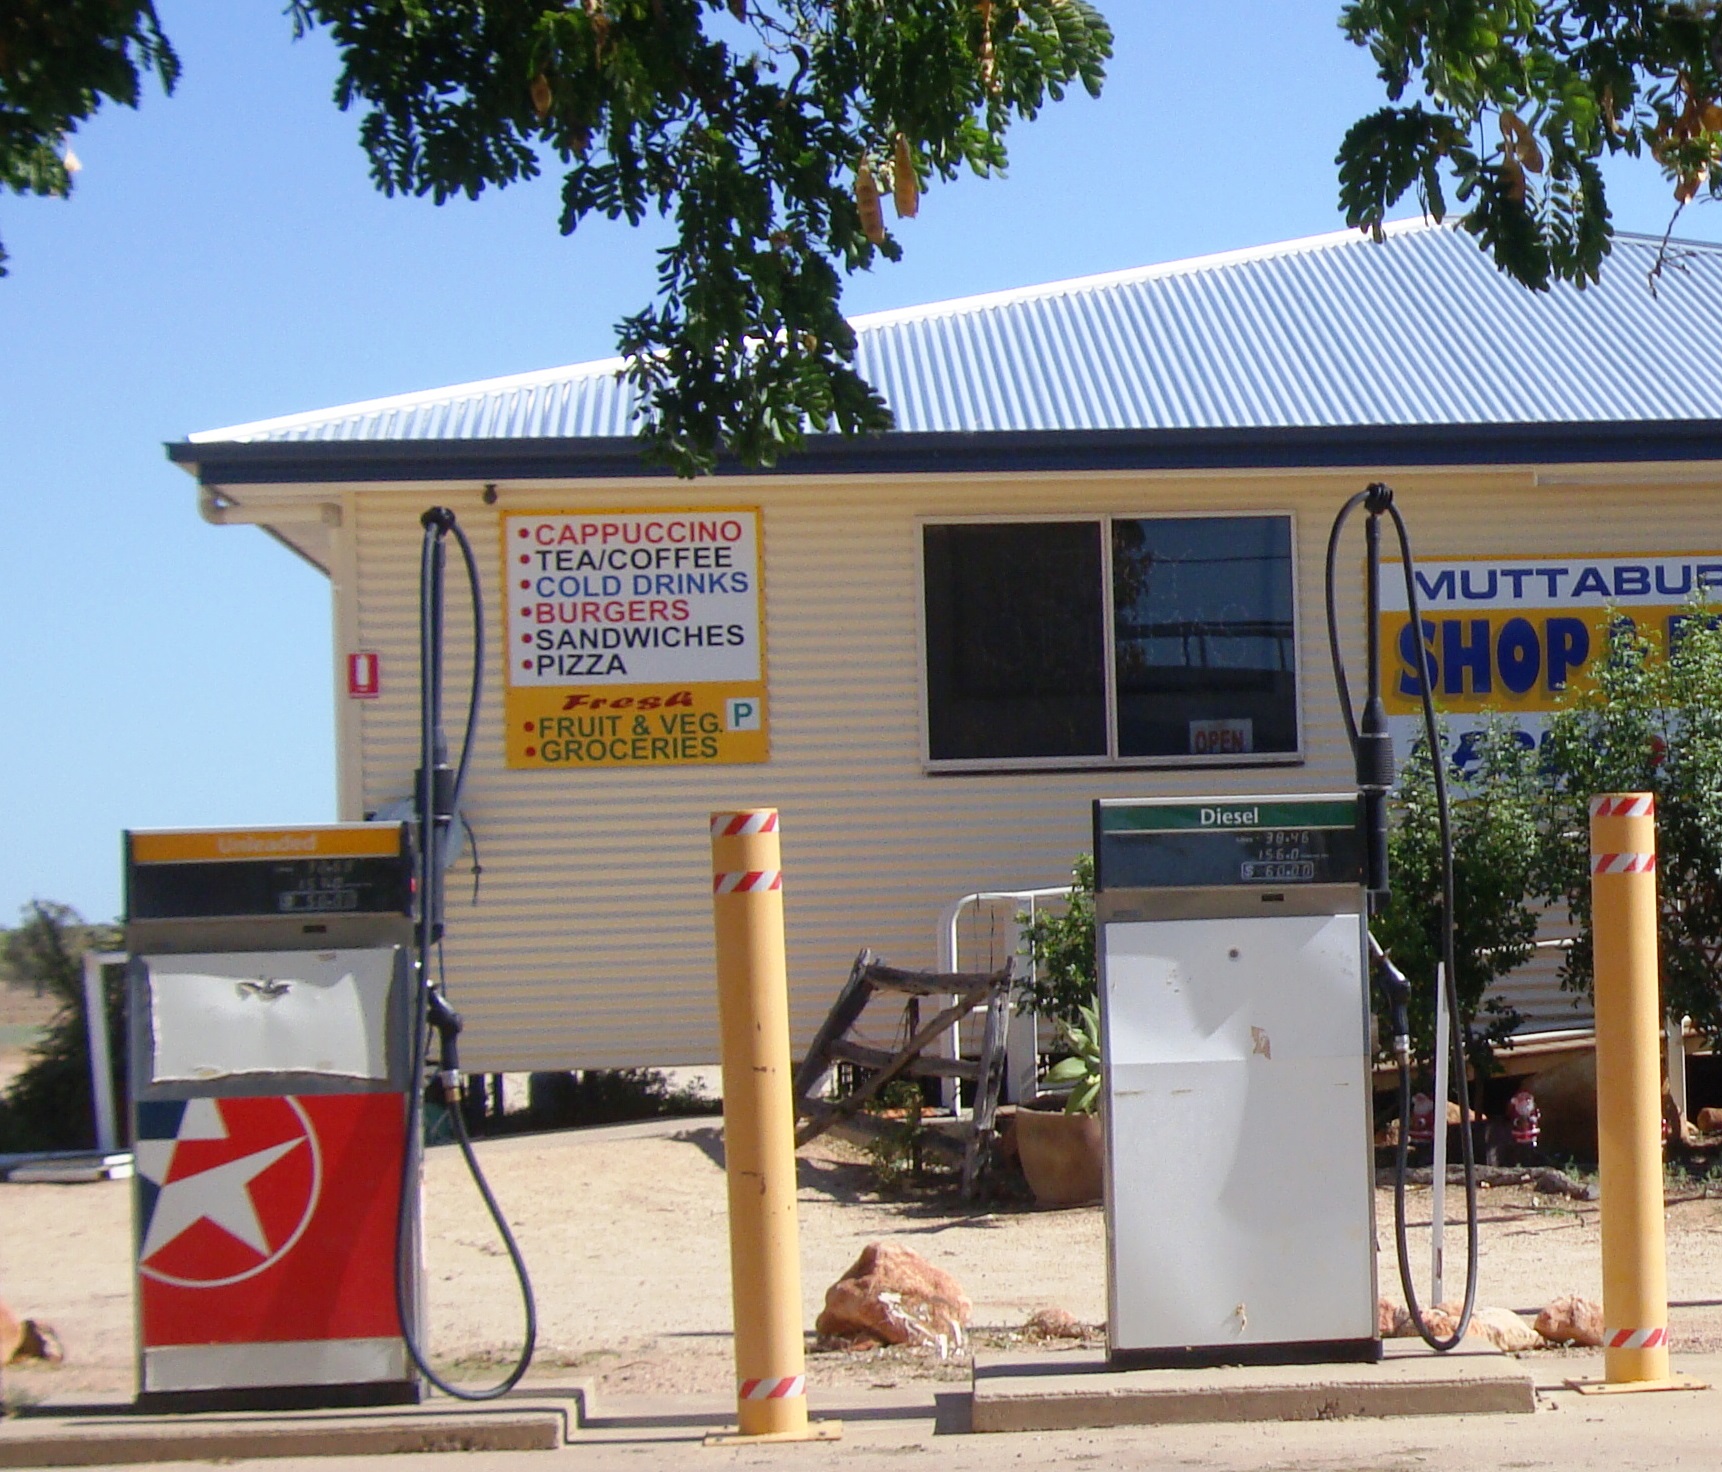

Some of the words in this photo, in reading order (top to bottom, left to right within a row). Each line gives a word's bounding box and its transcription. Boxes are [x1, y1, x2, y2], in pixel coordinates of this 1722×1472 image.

[535, 520, 742, 545] CAPPUCCINO
[535, 547, 732, 571] TEA/COFFEE
[536, 575, 621, 598] COLD
[633, 572, 748, 596] DRINKS
[536, 600, 689, 624] BURGERS
[536, 625, 745, 651] SANDWICHES
[537, 653, 627, 677] PIZZA
[1399, 617, 1590, 696] SHOP
[562, 690, 693, 710] Fresh
[539, 715, 622, 738] FRUIT
[632, 715, 650, 736] &
[660, 713, 723, 735] VEG.
[733, 703, 752, 727] P
[540, 737, 718, 762] GROCERIES
[1195, 729, 1244, 753] OPEN
[1200, 807, 1259, 826] Diesel
